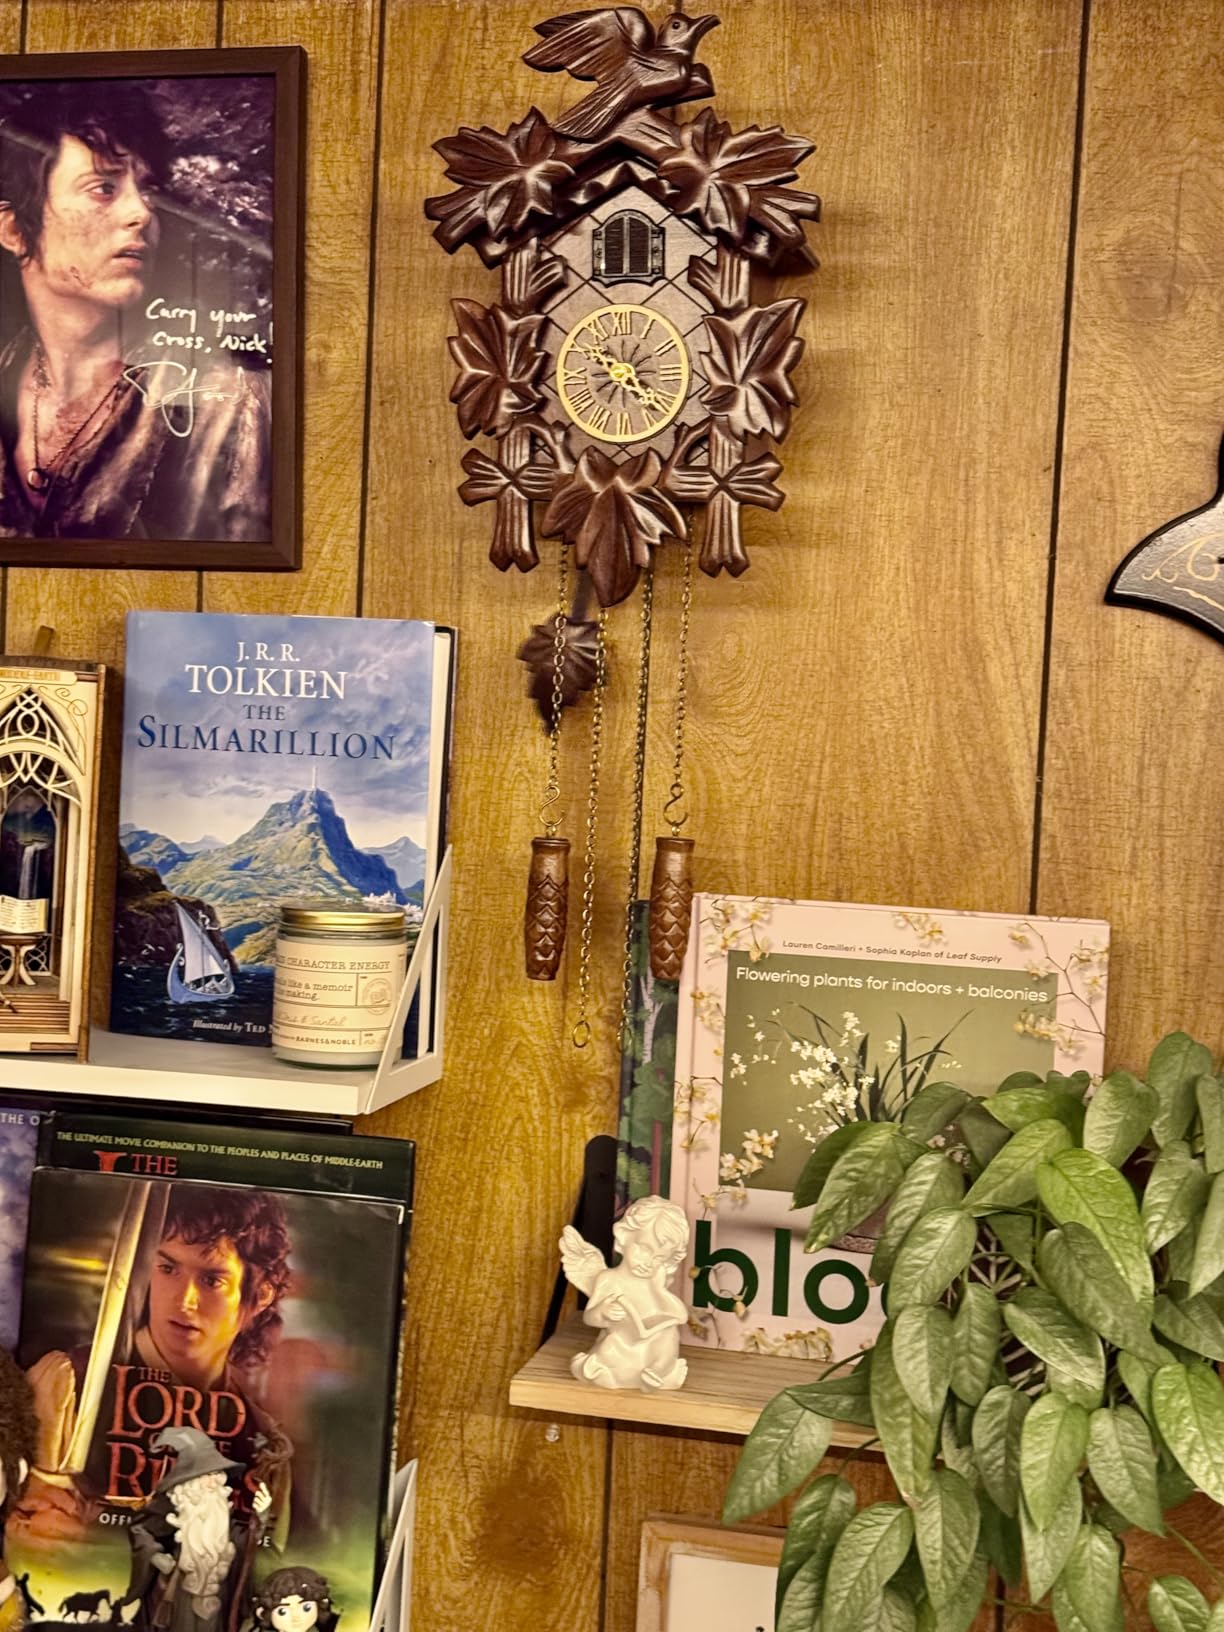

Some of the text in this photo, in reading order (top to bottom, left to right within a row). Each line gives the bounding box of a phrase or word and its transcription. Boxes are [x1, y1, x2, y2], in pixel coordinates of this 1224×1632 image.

[209, 309, 257, 338] your
[184, 663, 349, 700] TOLKIEN
[243, 703, 287, 721] THE
[137, 714, 396, 761] SILMARILLION
[782, 941, 814, 950] Lauren
[815, 942, 856, 953] Camilleri
[865, 945, 897, 956] Sophia
[900, 948, 932, 959] Kaplan
[934, 951, 944, 959] of
[946, 951, 968, 961] Leaf
[969, 953, 1002, 964] Supply
[349, 961, 391, 971] ENERGY
[312, 983, 354, 992] memoir
[736, 966, 810, 988] Flowering
[813, 973, 864, 989] plants
[866, 975, 889, 991] for
[891, 977, 952, 996] indoors
[967, 983, 1049, 1003] balconies
[232, 1022, 243, 1033] by
[0, 1111, 25, 1125] THE
[56, 1131, 384, 1169] THE ULTIMATE MOVIE COMPANION TO THE PEOPLES AND PLACES OF MIDDLE-EARTH
[130, 1152, 178, 1176] THE
[692, 1219, 888, 1325] blo
[138, 1366, 172, 1383] THE
[106, 1363, 247, 1439] LORD
